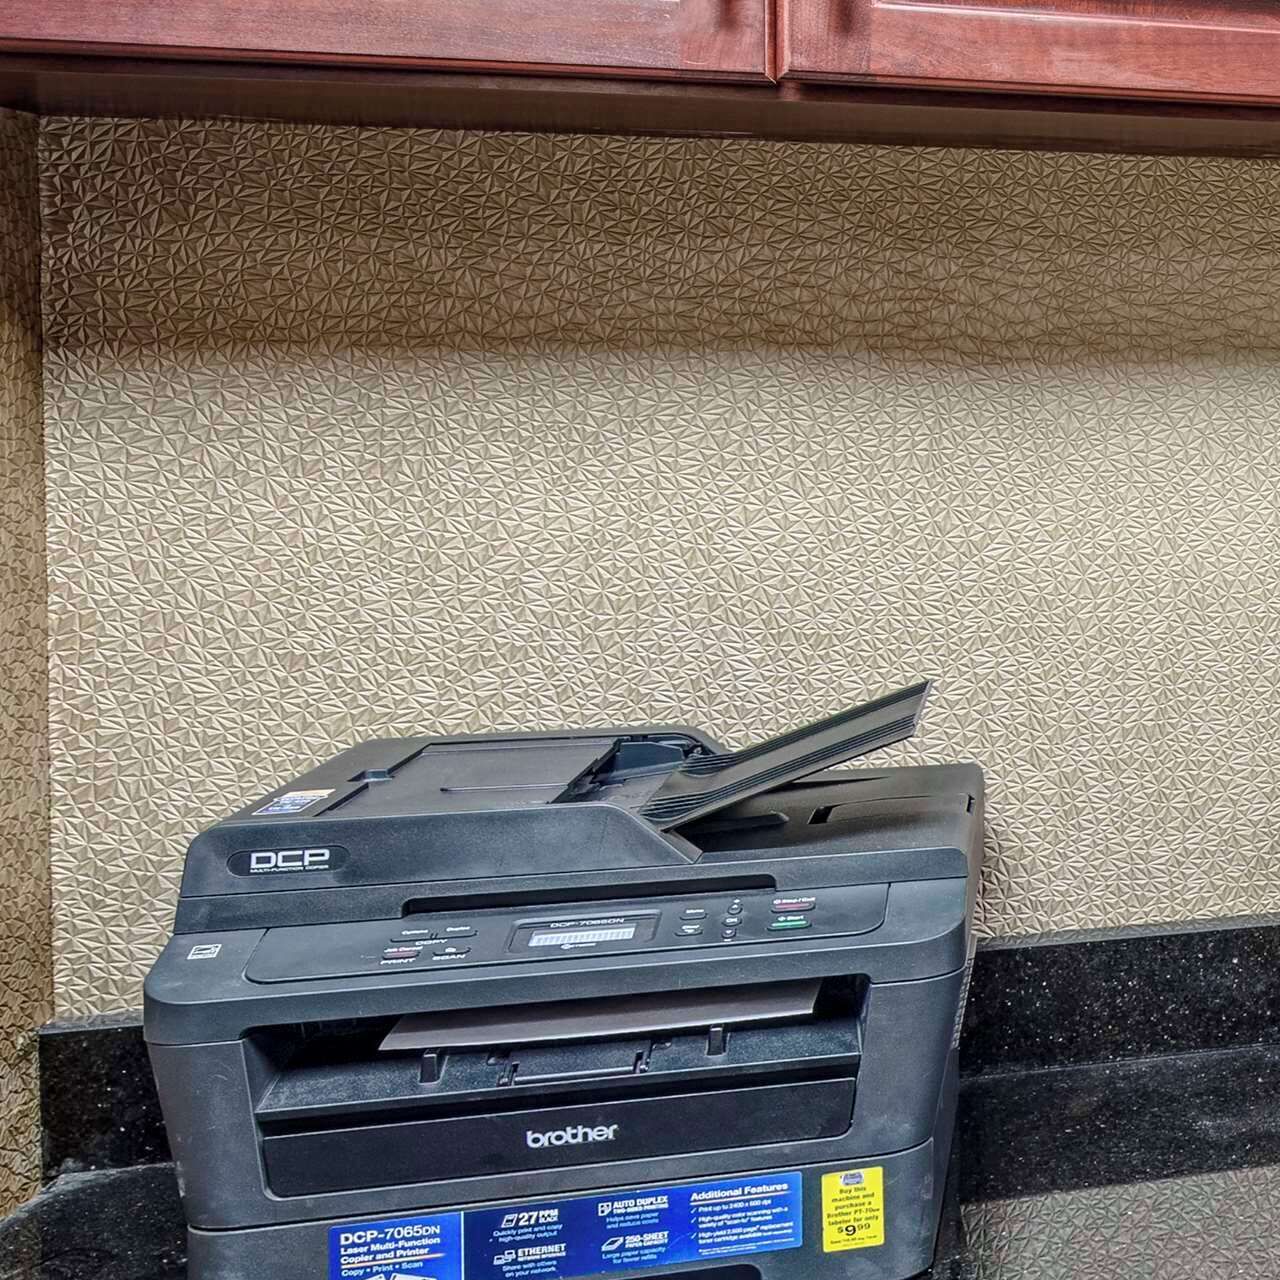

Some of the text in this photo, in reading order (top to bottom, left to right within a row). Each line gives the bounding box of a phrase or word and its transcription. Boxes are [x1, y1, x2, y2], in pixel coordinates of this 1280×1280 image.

[250, 849, 330, 869] DCP
[526, 1124, 619, 1148] brother
[690, 1183, 789, 1202] Additional Features
[832, 1195, 860, 1203] machine
[613, 1195, 669, 1209] AUTO DUPLEX
[835, 1203, 866, 1211] purchase
[518, 1211, 539, 1227] 27
[699, 1213, 731, 1223] High-quality
[827, 1211, 852, 1219] Brother
[341, 1225, 441, 1245] DCP-7065DN
[493, 1229, 517, 1237] Quickly
[518, 1227, 533, 1235] print
[625, 1231, 670, 1242] 250-SHEET
[699, 1221, 794, 1239] High-yield replacement
[499, 1234, 536, 1243] high-quality
[714, 1235, 739, 1243] cartridge
[341, 1238, 441, 1255] Laser Multi-Function
[518, 1243, 567, 1257] ETHERNET
[341, 1254, 376, 1265] Copier
[396, 1248, 430, 1258] Printer
[342, 1262, 424, 1277] Copy Print Scan
[515, 1270, 530, 1278] your
